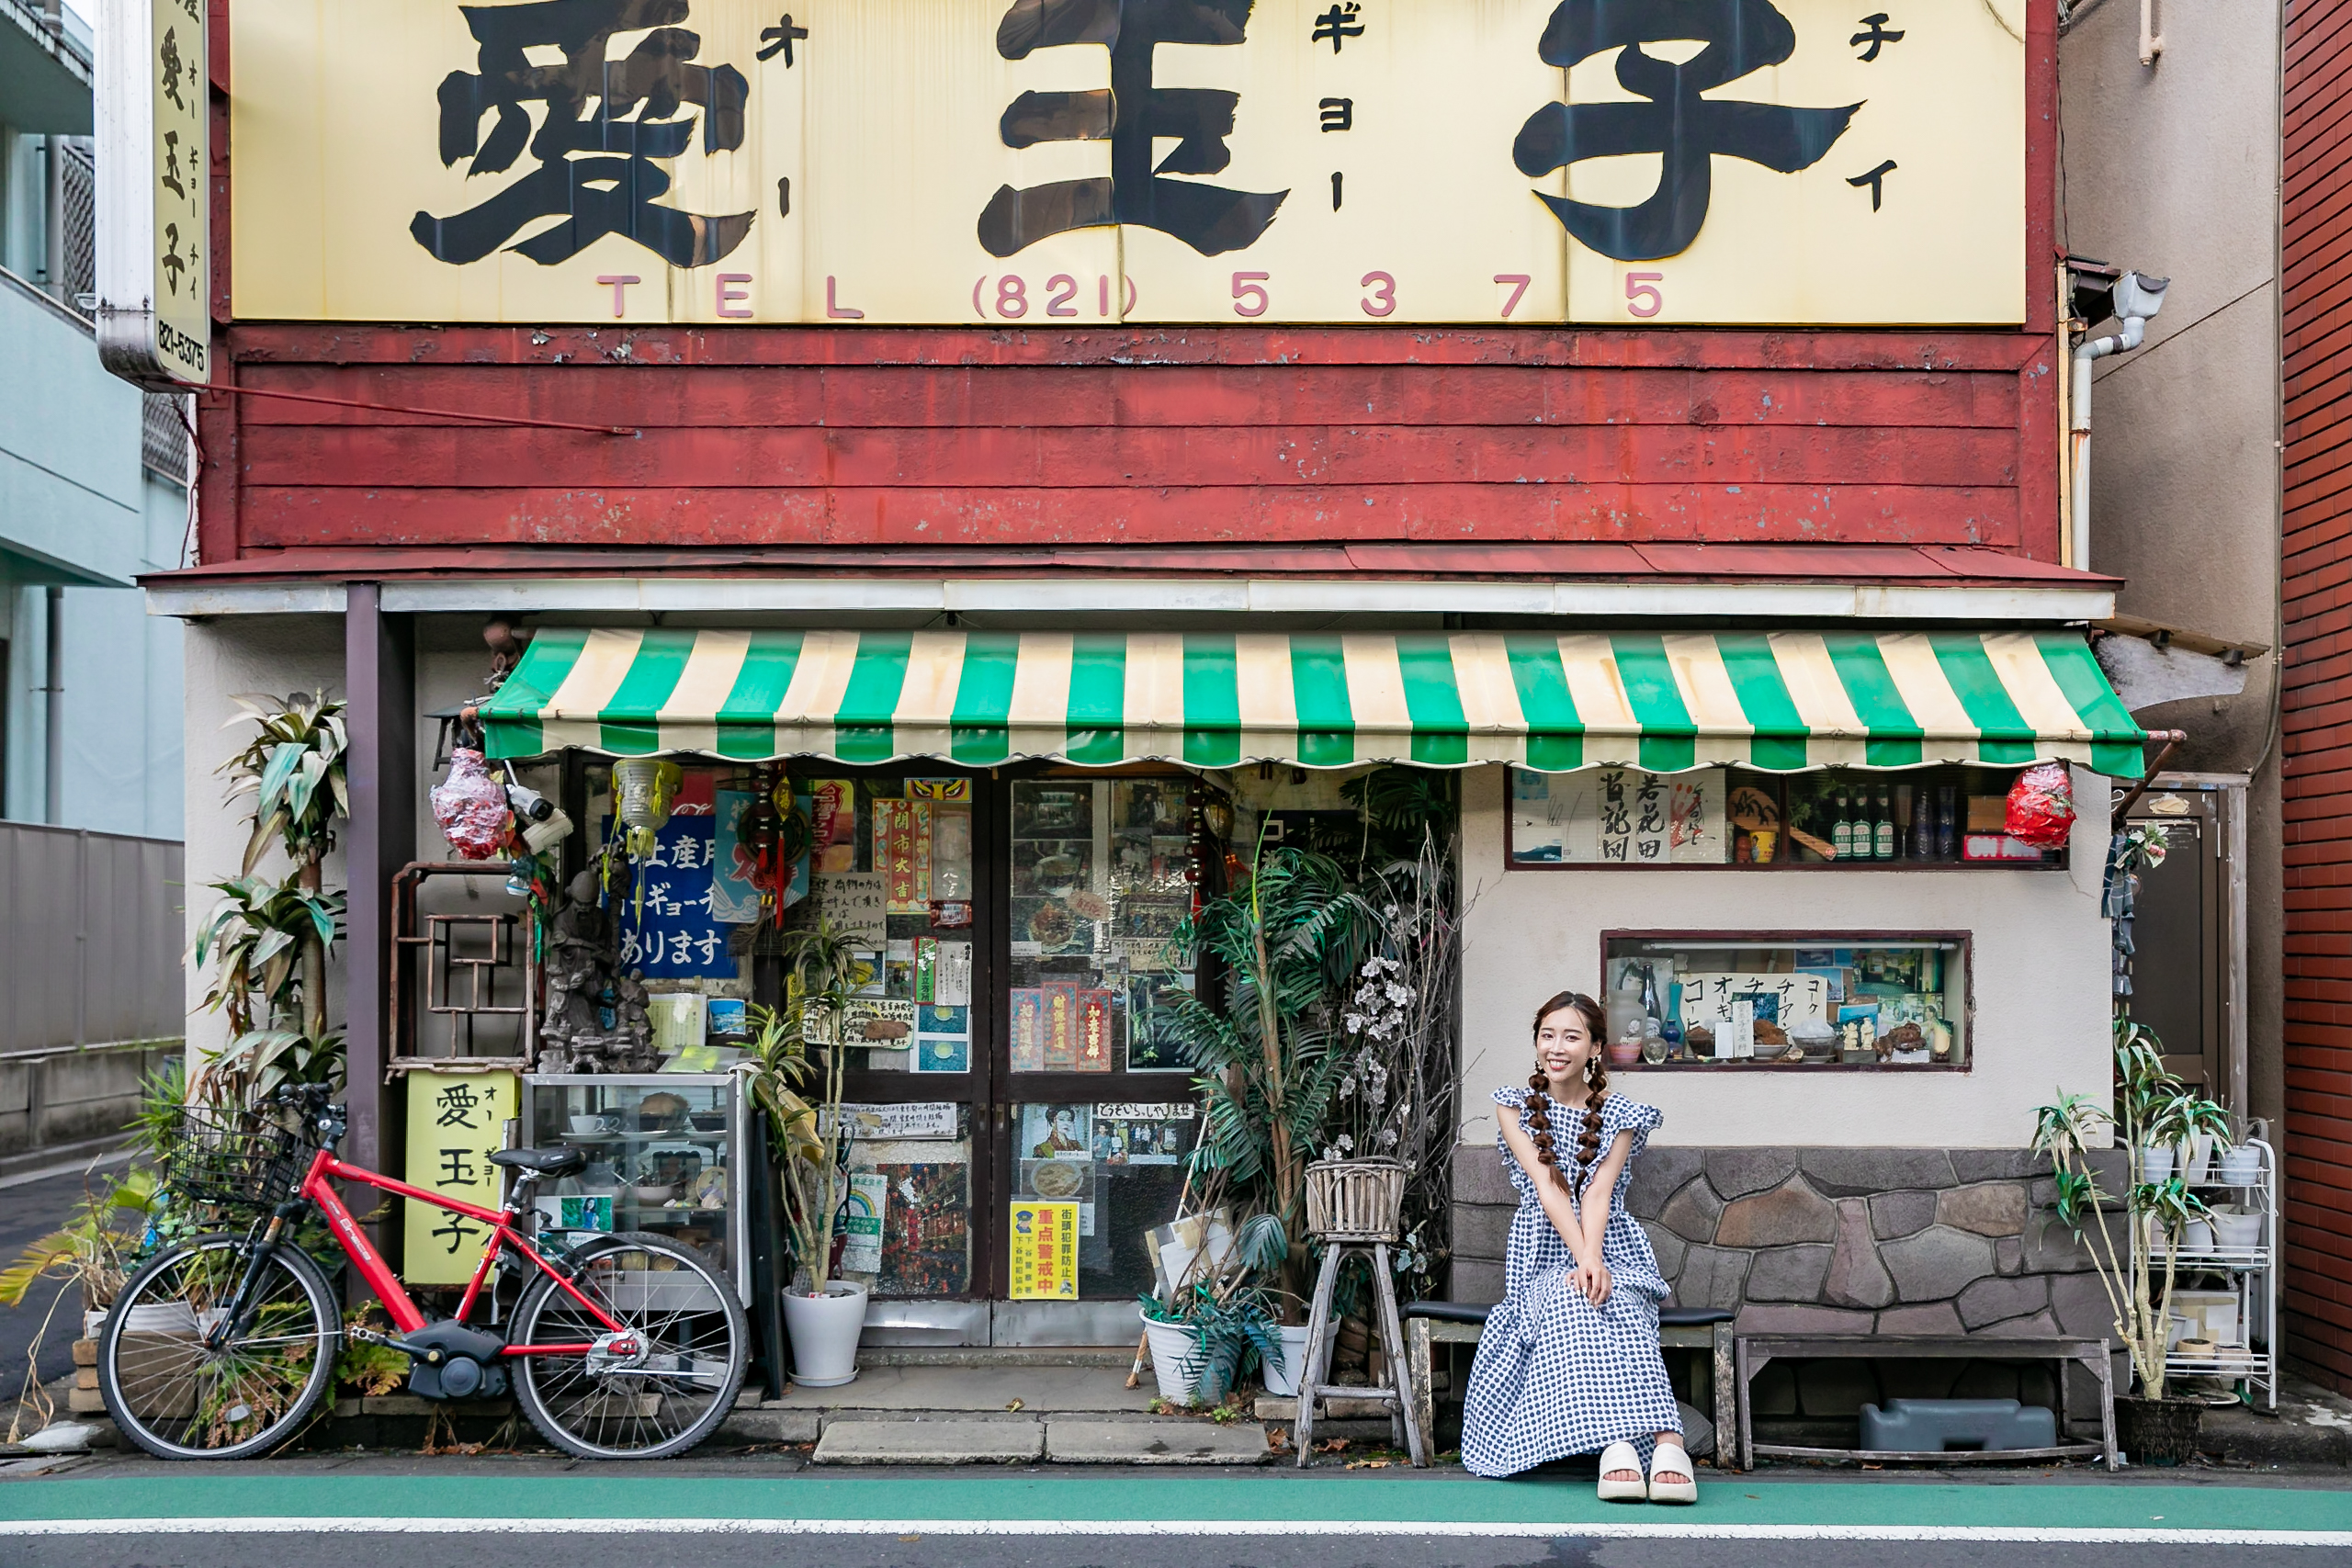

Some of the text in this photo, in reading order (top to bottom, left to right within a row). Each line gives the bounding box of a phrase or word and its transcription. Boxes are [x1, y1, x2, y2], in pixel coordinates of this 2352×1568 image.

[757, 14, 808, 219] オー
[1312, 3, 1364, 214] ギョー
[1846, 12, 1906, 214] チイ
[161, 26, 185, 297] 愛玉子
[596, 270, 1665, 321] TEL (821) 5375
[159, 319, 204, 372] 821-5375
[893, 811, 911, 898] 開市大吉
[620, 882, 715, 916] ーギョーチ
[620, 928, 722, 964] あります
[432, 1082, 480, 1255] 愛玉子
[1037, 1209, 1054, 1294] 重点警戒中
[1060, 1209, 1072, 1278] 街頭犯罪防止
